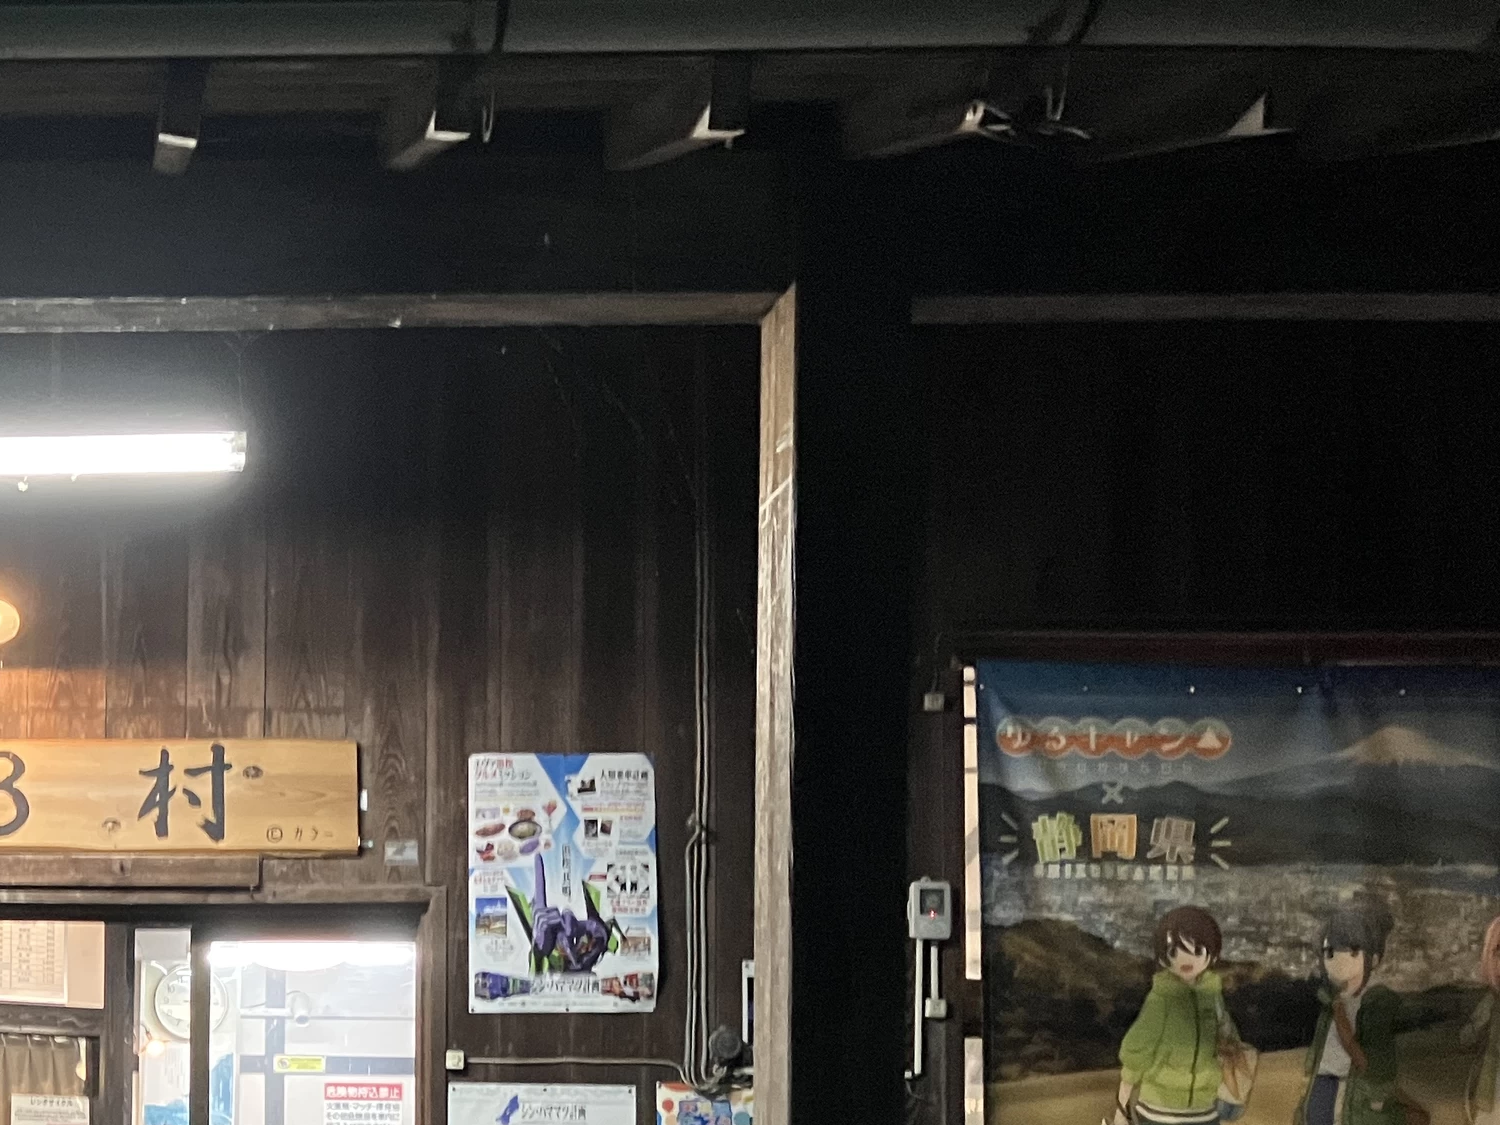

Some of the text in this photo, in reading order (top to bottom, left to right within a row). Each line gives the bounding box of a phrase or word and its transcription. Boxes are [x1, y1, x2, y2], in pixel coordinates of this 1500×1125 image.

[1031, 810, 1196, 864] 静岡県
[326, 1086, 400, 1098] 危険物持込禁止
